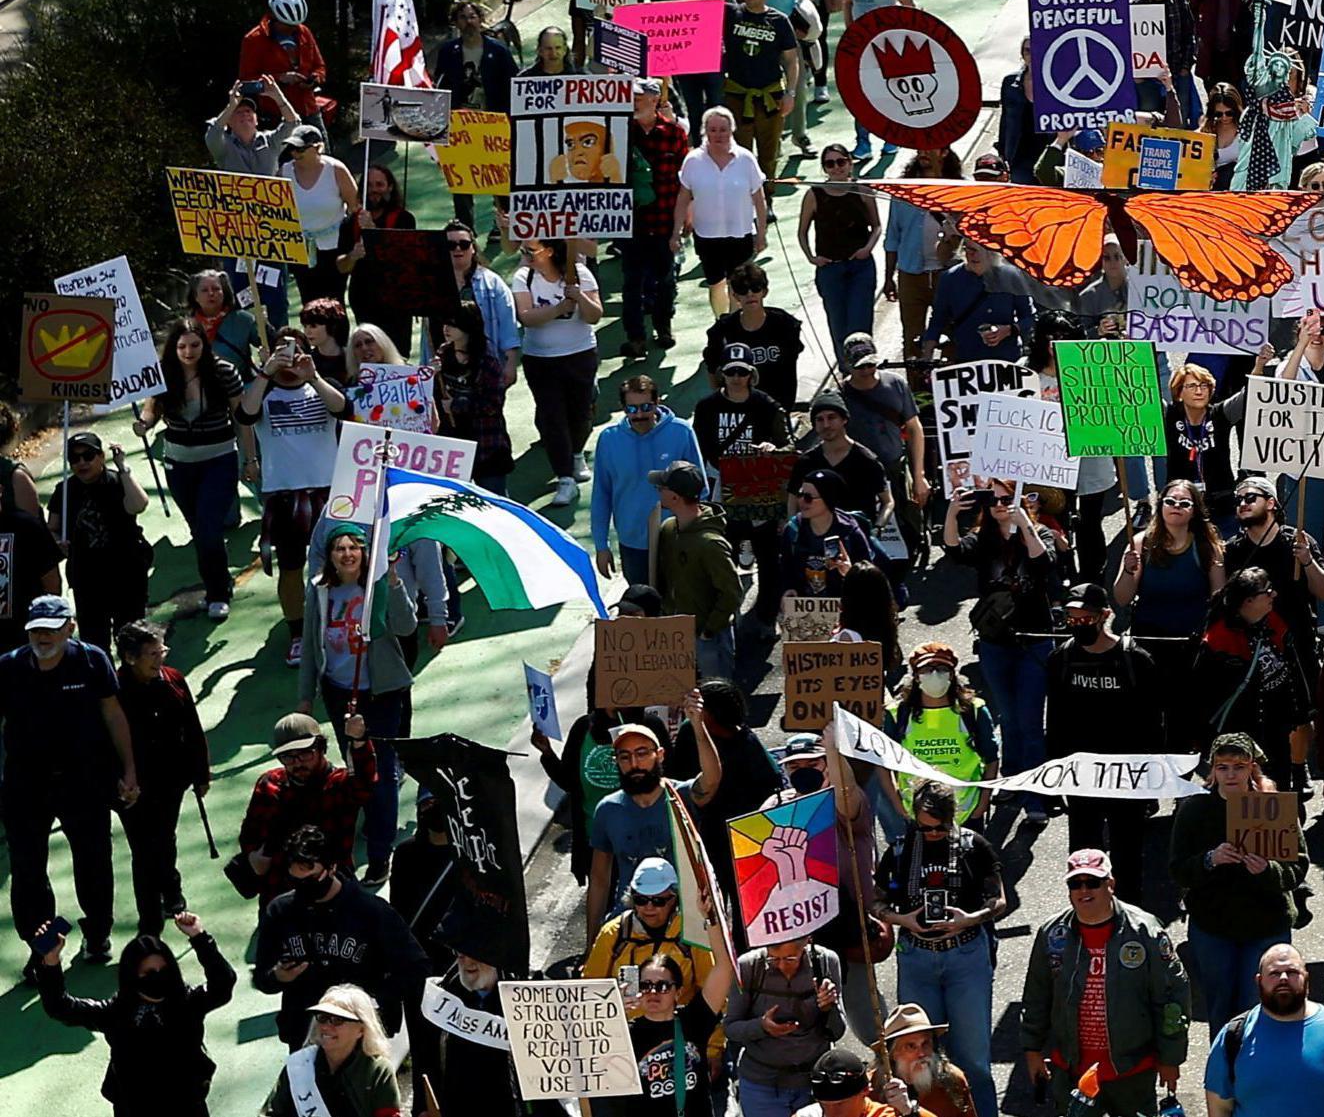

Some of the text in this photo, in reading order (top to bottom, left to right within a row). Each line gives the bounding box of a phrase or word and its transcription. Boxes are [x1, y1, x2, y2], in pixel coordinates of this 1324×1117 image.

[1033, 8, 1123, 28] PEACEFUL
[515, 80, 631, 106] TRUMP PRISON
[525, 95, 555, 110] FOR
[1039, 110, 1136, 128] PROTESTOR
[1144, 149, 1170, 158] TRANS
[1143, 159, 1172, 168] PEOPLE
[1142, 169, 1173, 179] BELONG
[514, 191, 633, 213] MAKE AMERICA
[514, 211, 631, 238] SAFE AGAIN
[1257, 409, 1294, 429] FOR
[511, 986, 589, 1004] SOMEONE
[512, 1003, 616, 1022] STRUGGLED
[523, 1021, 611, 1039] FOR YOUR
[527, 1038, 611, 1058] RIGHT TO
[540, 1057, 606, 1076] VOTE.
[540, 1075, 611, 1093] USE IT.
